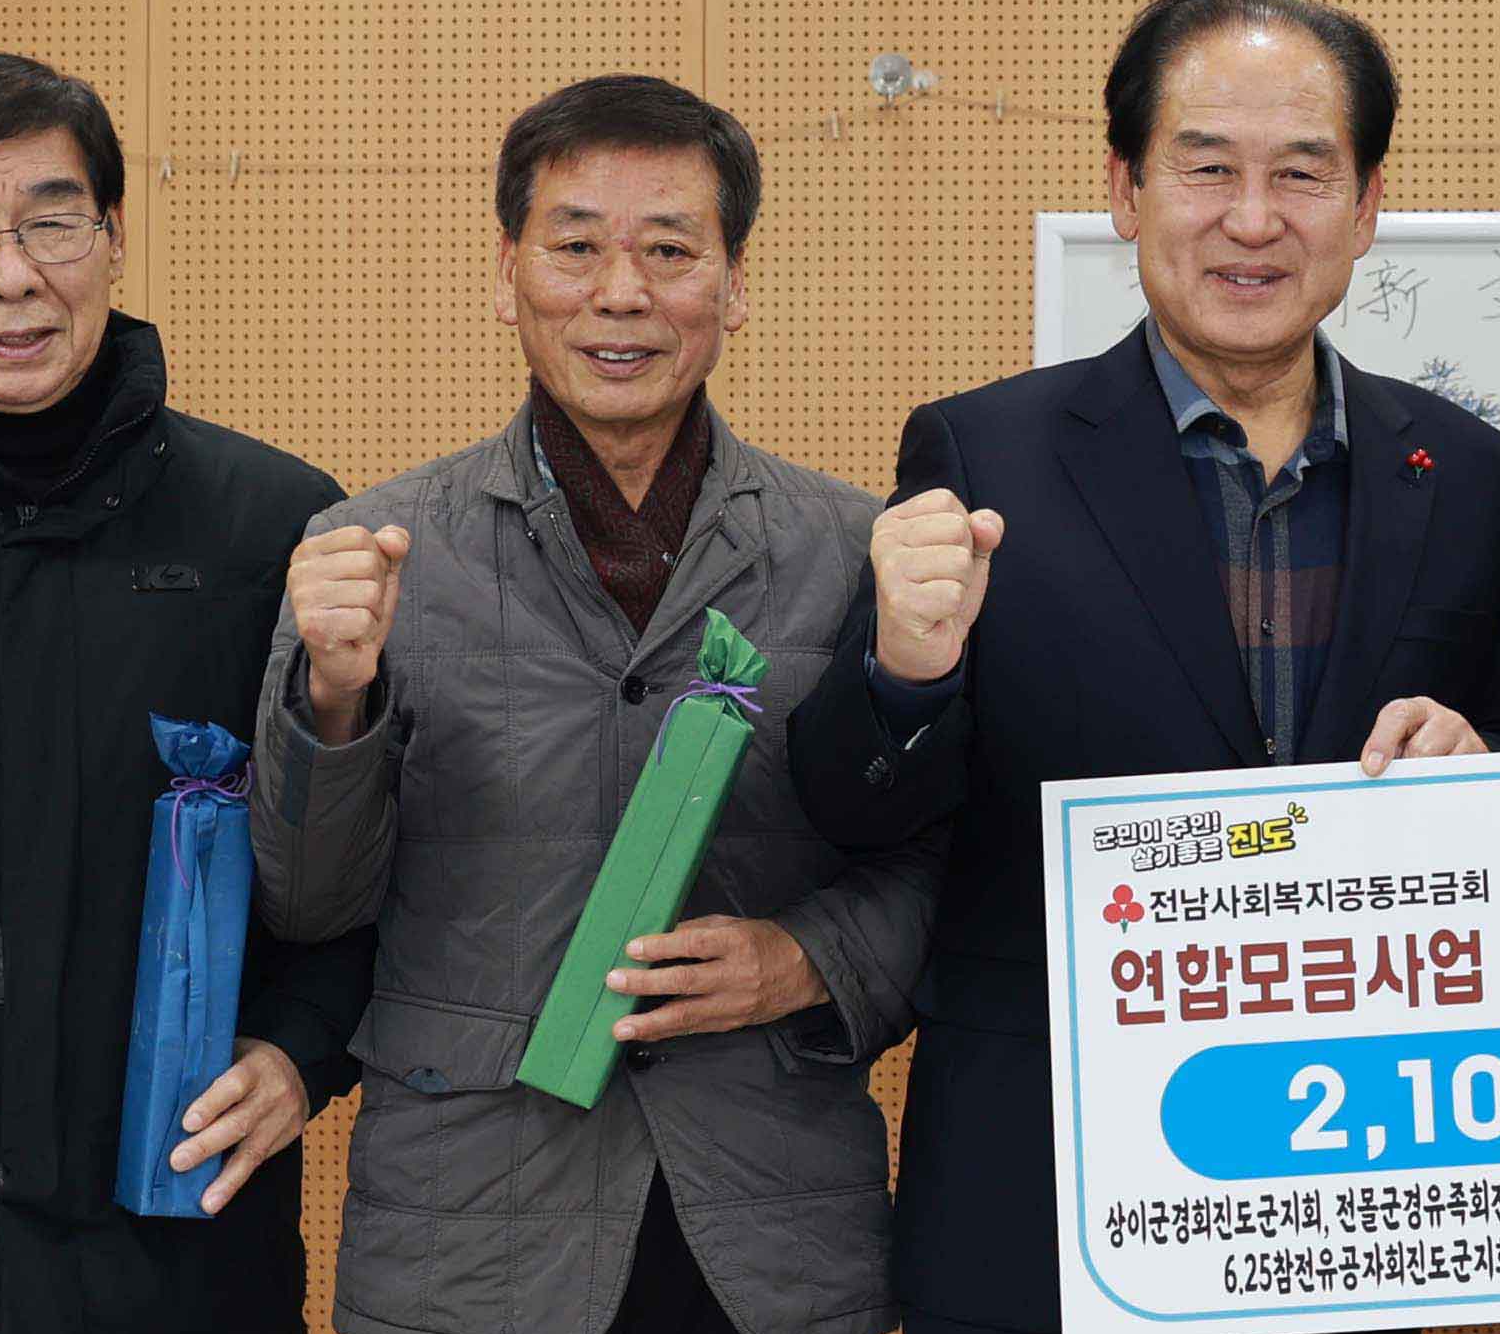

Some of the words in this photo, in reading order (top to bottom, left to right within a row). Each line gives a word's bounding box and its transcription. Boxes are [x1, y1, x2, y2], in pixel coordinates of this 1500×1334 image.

[1093, 818, 1162, 851] 군민이
[1166, 810, 1221, 839] 주인!
[1132, 836, 1222, 872] 살기좋은
[1227, 817, 1296, 859] 진도
[1148, 869, 1490, 924] 전남사회복지공동모금회
[1110, 928, 1485, 1026] 연합모금사업
[1106, 1187, 1330, 1248] 상이군경회진도군지회,
